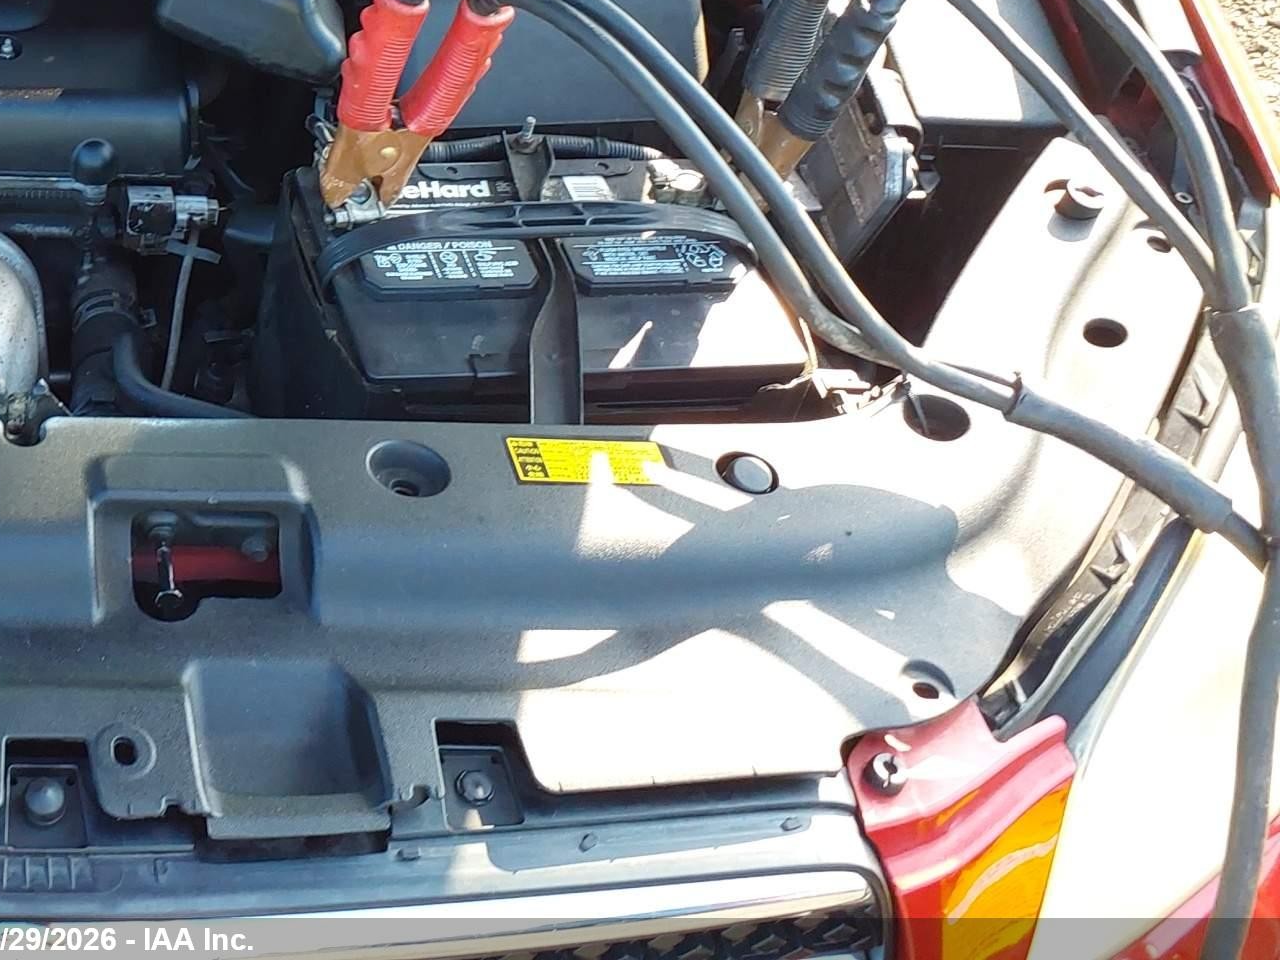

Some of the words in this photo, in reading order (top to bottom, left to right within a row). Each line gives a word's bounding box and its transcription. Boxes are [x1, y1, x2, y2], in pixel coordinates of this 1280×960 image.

[397, 180, 491, 199] eHard
[397, 241, 442, 250] DANGER
[451, 240, 493, 249] POISON
